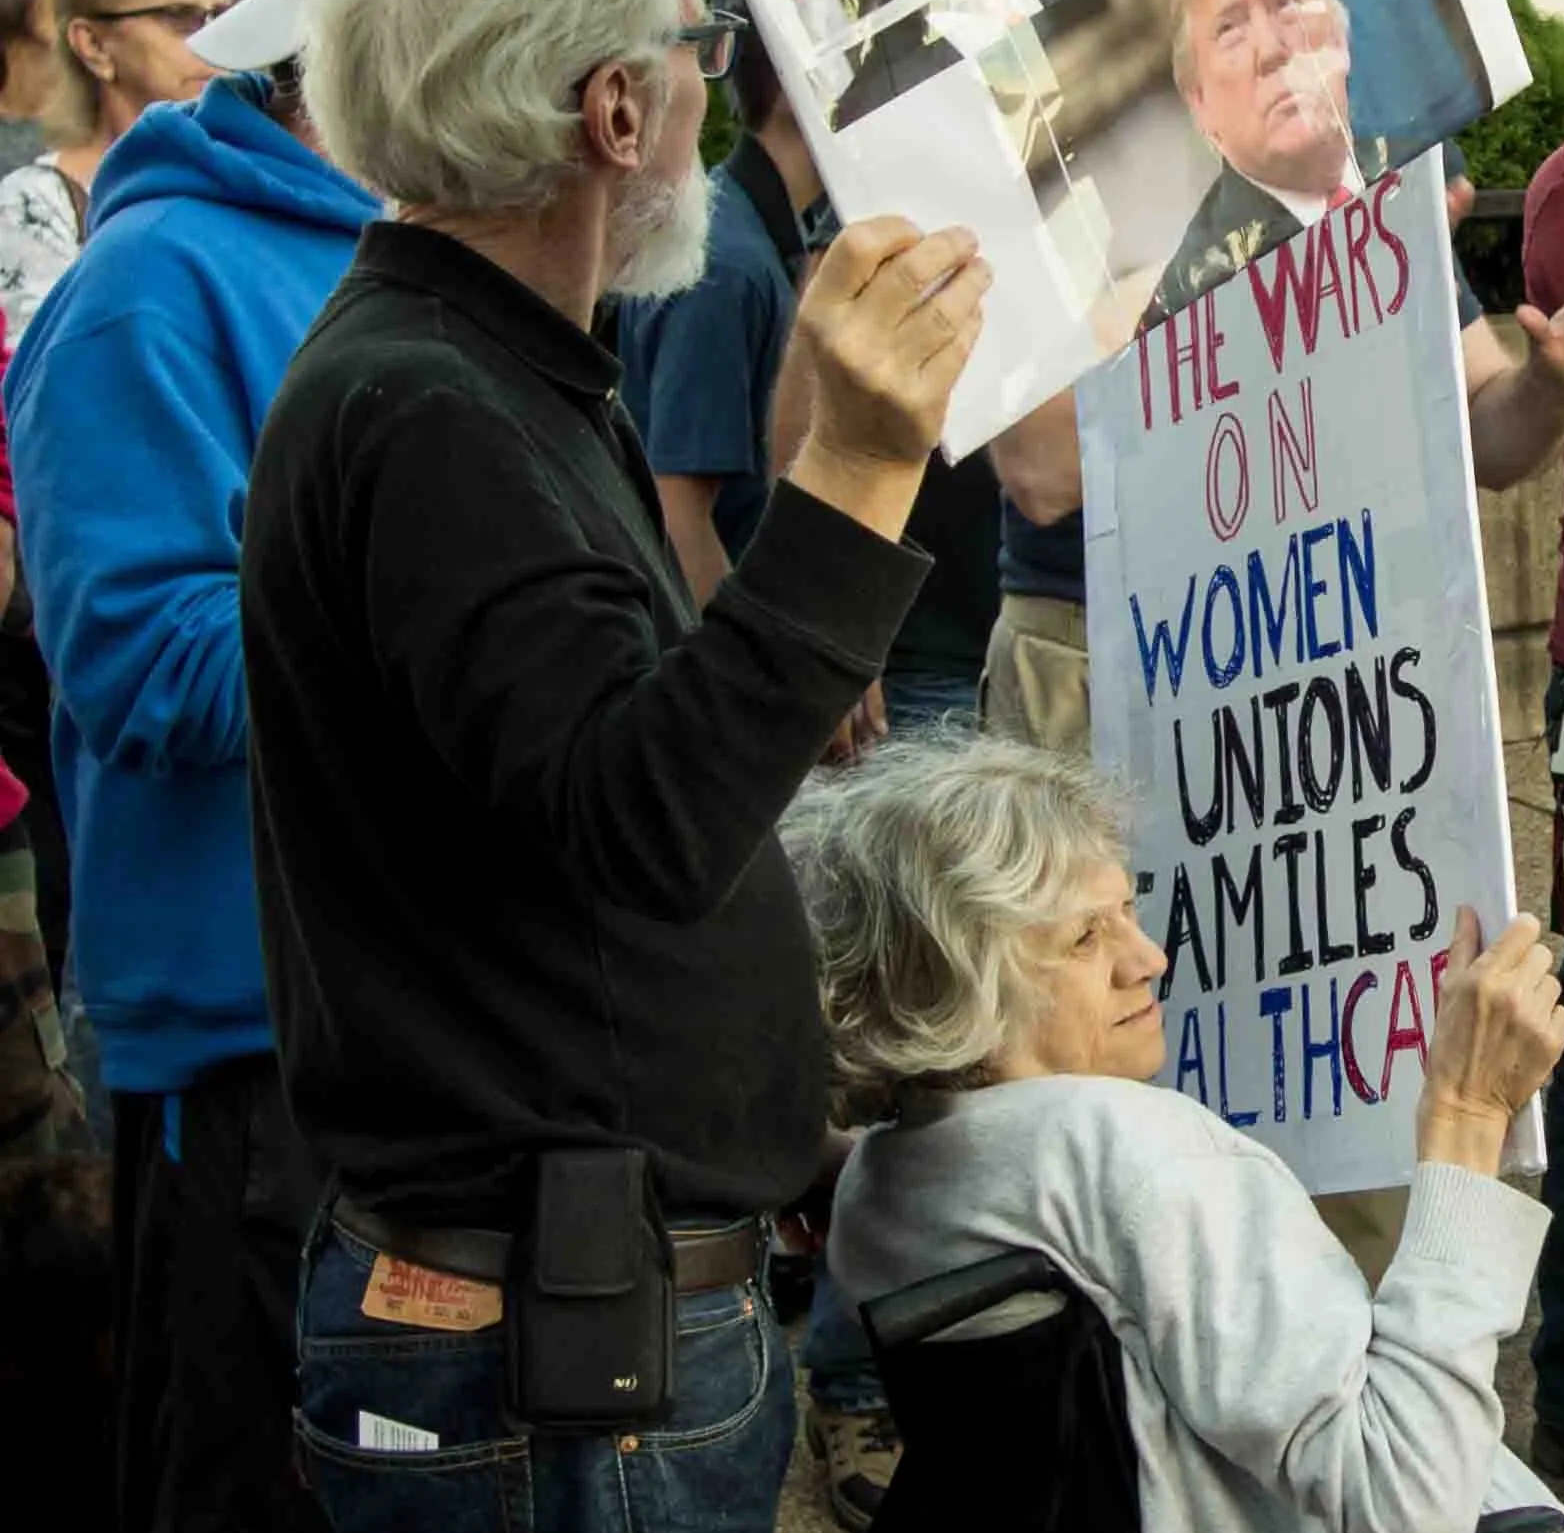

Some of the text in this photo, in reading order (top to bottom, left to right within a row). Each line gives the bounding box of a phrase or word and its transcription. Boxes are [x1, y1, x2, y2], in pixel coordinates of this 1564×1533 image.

[1136, 170, 1410, 430] THE WARS
[1205, 376, 1320, 543] ON
[1129, 507, 1379, 708] WOMEN
[1173, 646, 1438, 847] UNIONS
[1137, 806, 1440, 1002] AMILES
